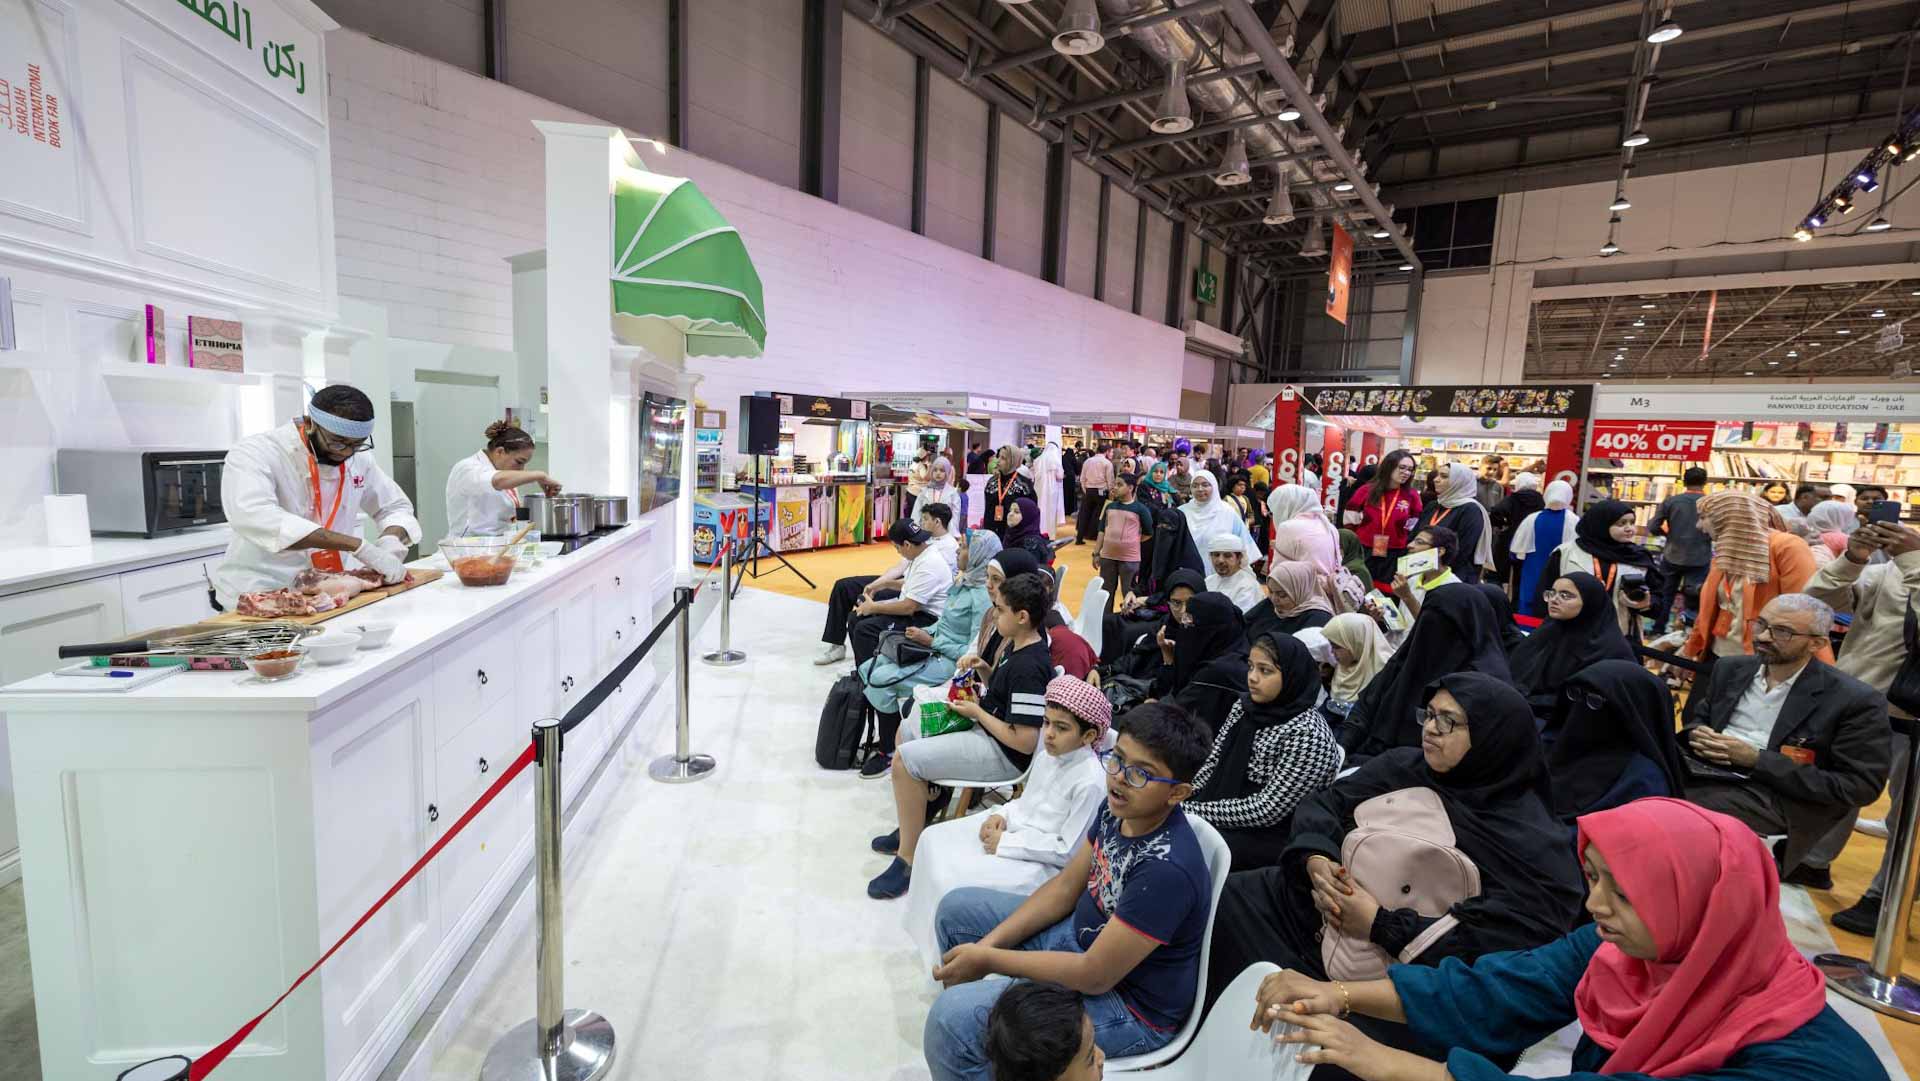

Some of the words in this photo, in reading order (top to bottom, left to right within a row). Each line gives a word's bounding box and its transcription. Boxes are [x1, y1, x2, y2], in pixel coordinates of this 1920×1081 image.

[263, 41, 305, 94] ركن
[13, 86, 30, 136] SHARJAH
[28, 63, 46, 143] INTERNATIONAL
[46, 94, 58, 118] FAIR
[48, 118, 61, 149] BOOK
[194, 338, 242, 351] ETHIOPIA
[1314, 389, 1432, 413] GRAPHIC
[1449, 388, 1574, 414] NOVELS
[1630, 397, 1650, 407] M3
[1636, 424, 1667, 432] FLAT
[1595, 433, 1649, 450] 40%
[1657, 434, 1708, 452] OFF
